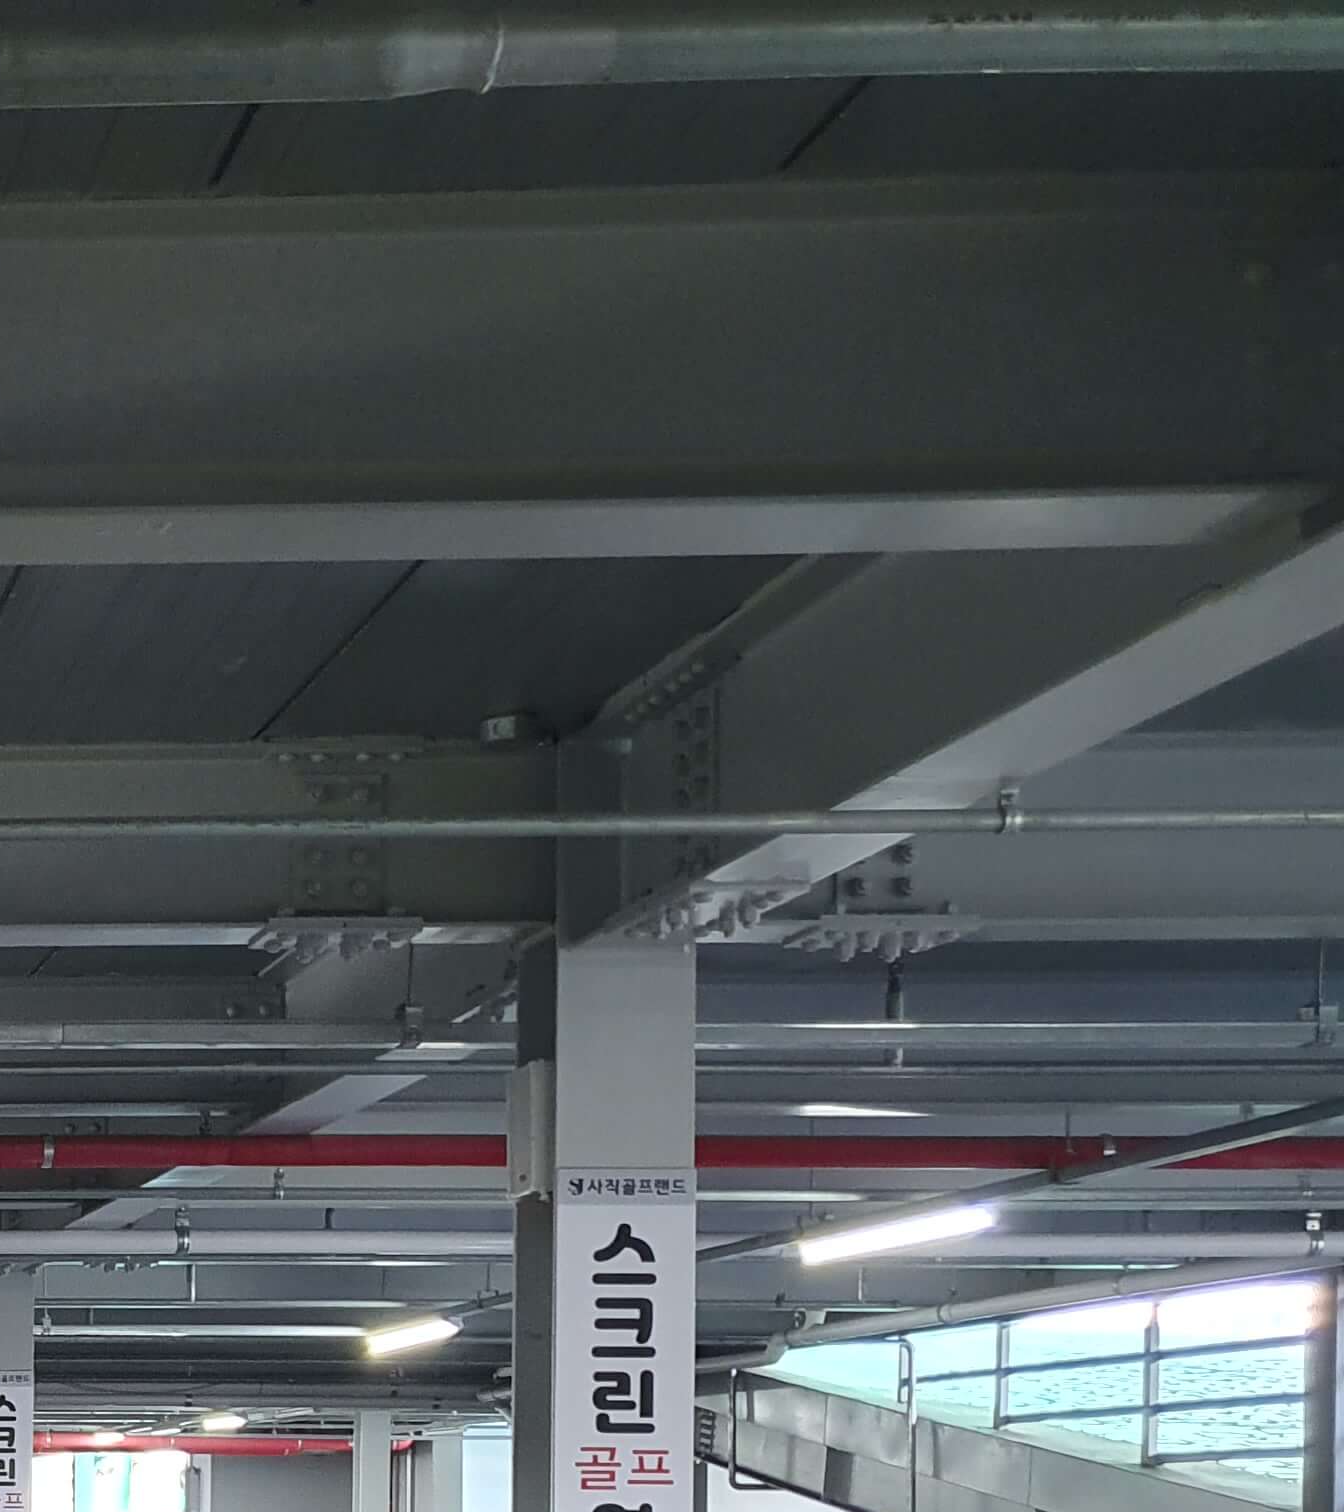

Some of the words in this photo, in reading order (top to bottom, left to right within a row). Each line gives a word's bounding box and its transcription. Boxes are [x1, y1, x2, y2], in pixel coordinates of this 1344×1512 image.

[587, 1178, 687, 1196] 사직골프랜드
[591, 1222, 657, 1436] 스크린
[573, 1445, 674, 1491] 골프
